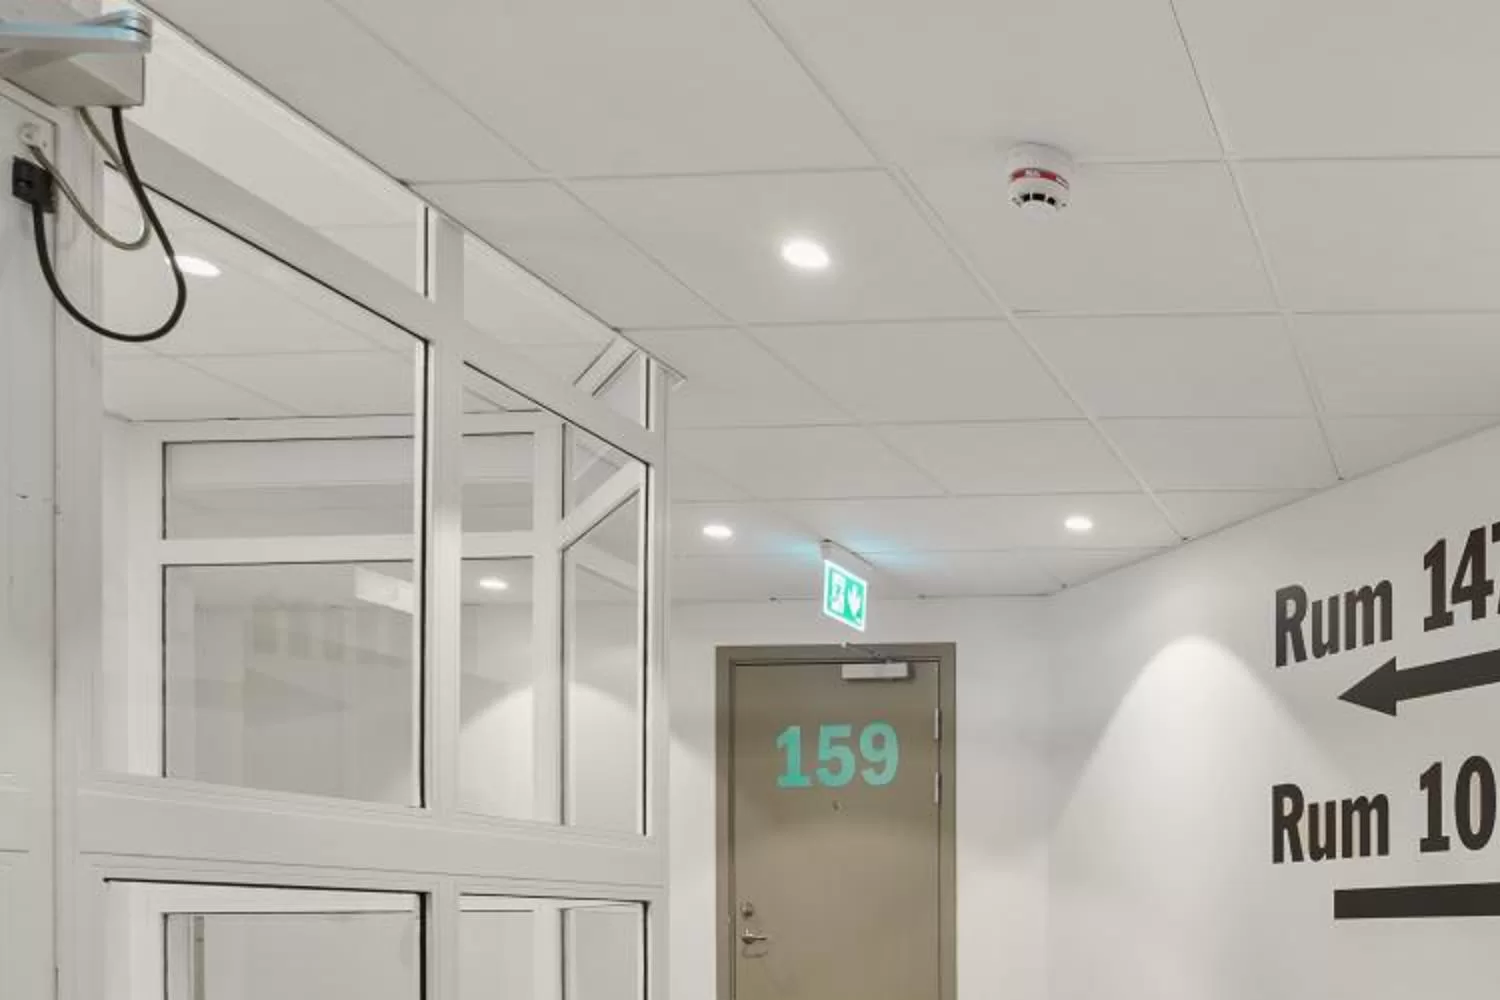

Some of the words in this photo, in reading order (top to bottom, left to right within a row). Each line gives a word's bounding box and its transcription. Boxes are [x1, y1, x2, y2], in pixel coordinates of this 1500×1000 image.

[1275, 579, 1393, 667] Rum
[776, 722, 899, 788] 159
[1271, 783, 1390, 864] Rum
